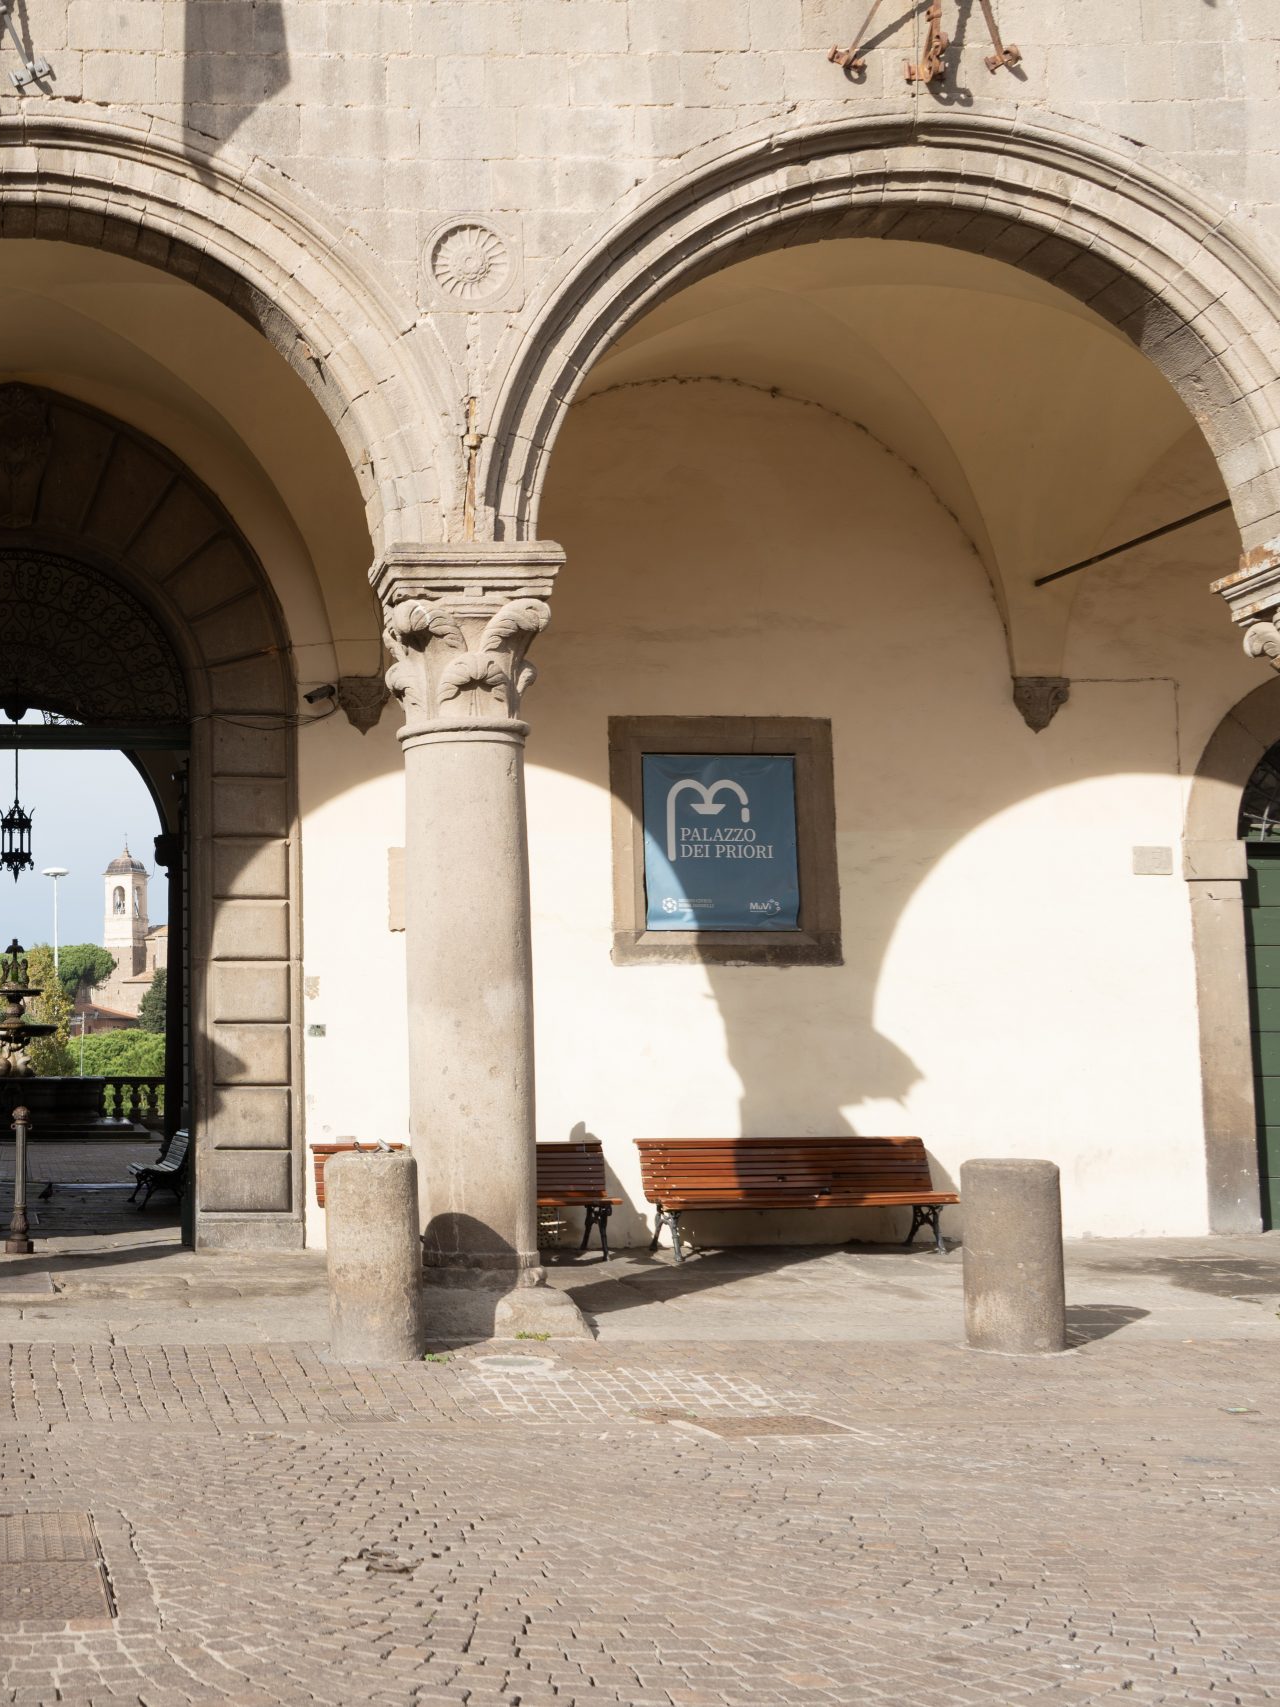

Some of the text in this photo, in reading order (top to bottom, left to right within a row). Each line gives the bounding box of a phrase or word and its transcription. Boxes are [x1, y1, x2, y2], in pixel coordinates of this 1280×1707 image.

[680, 828, 756, 842] PALAZZO
[680, 844, 774, 859] DEI PRIORI
